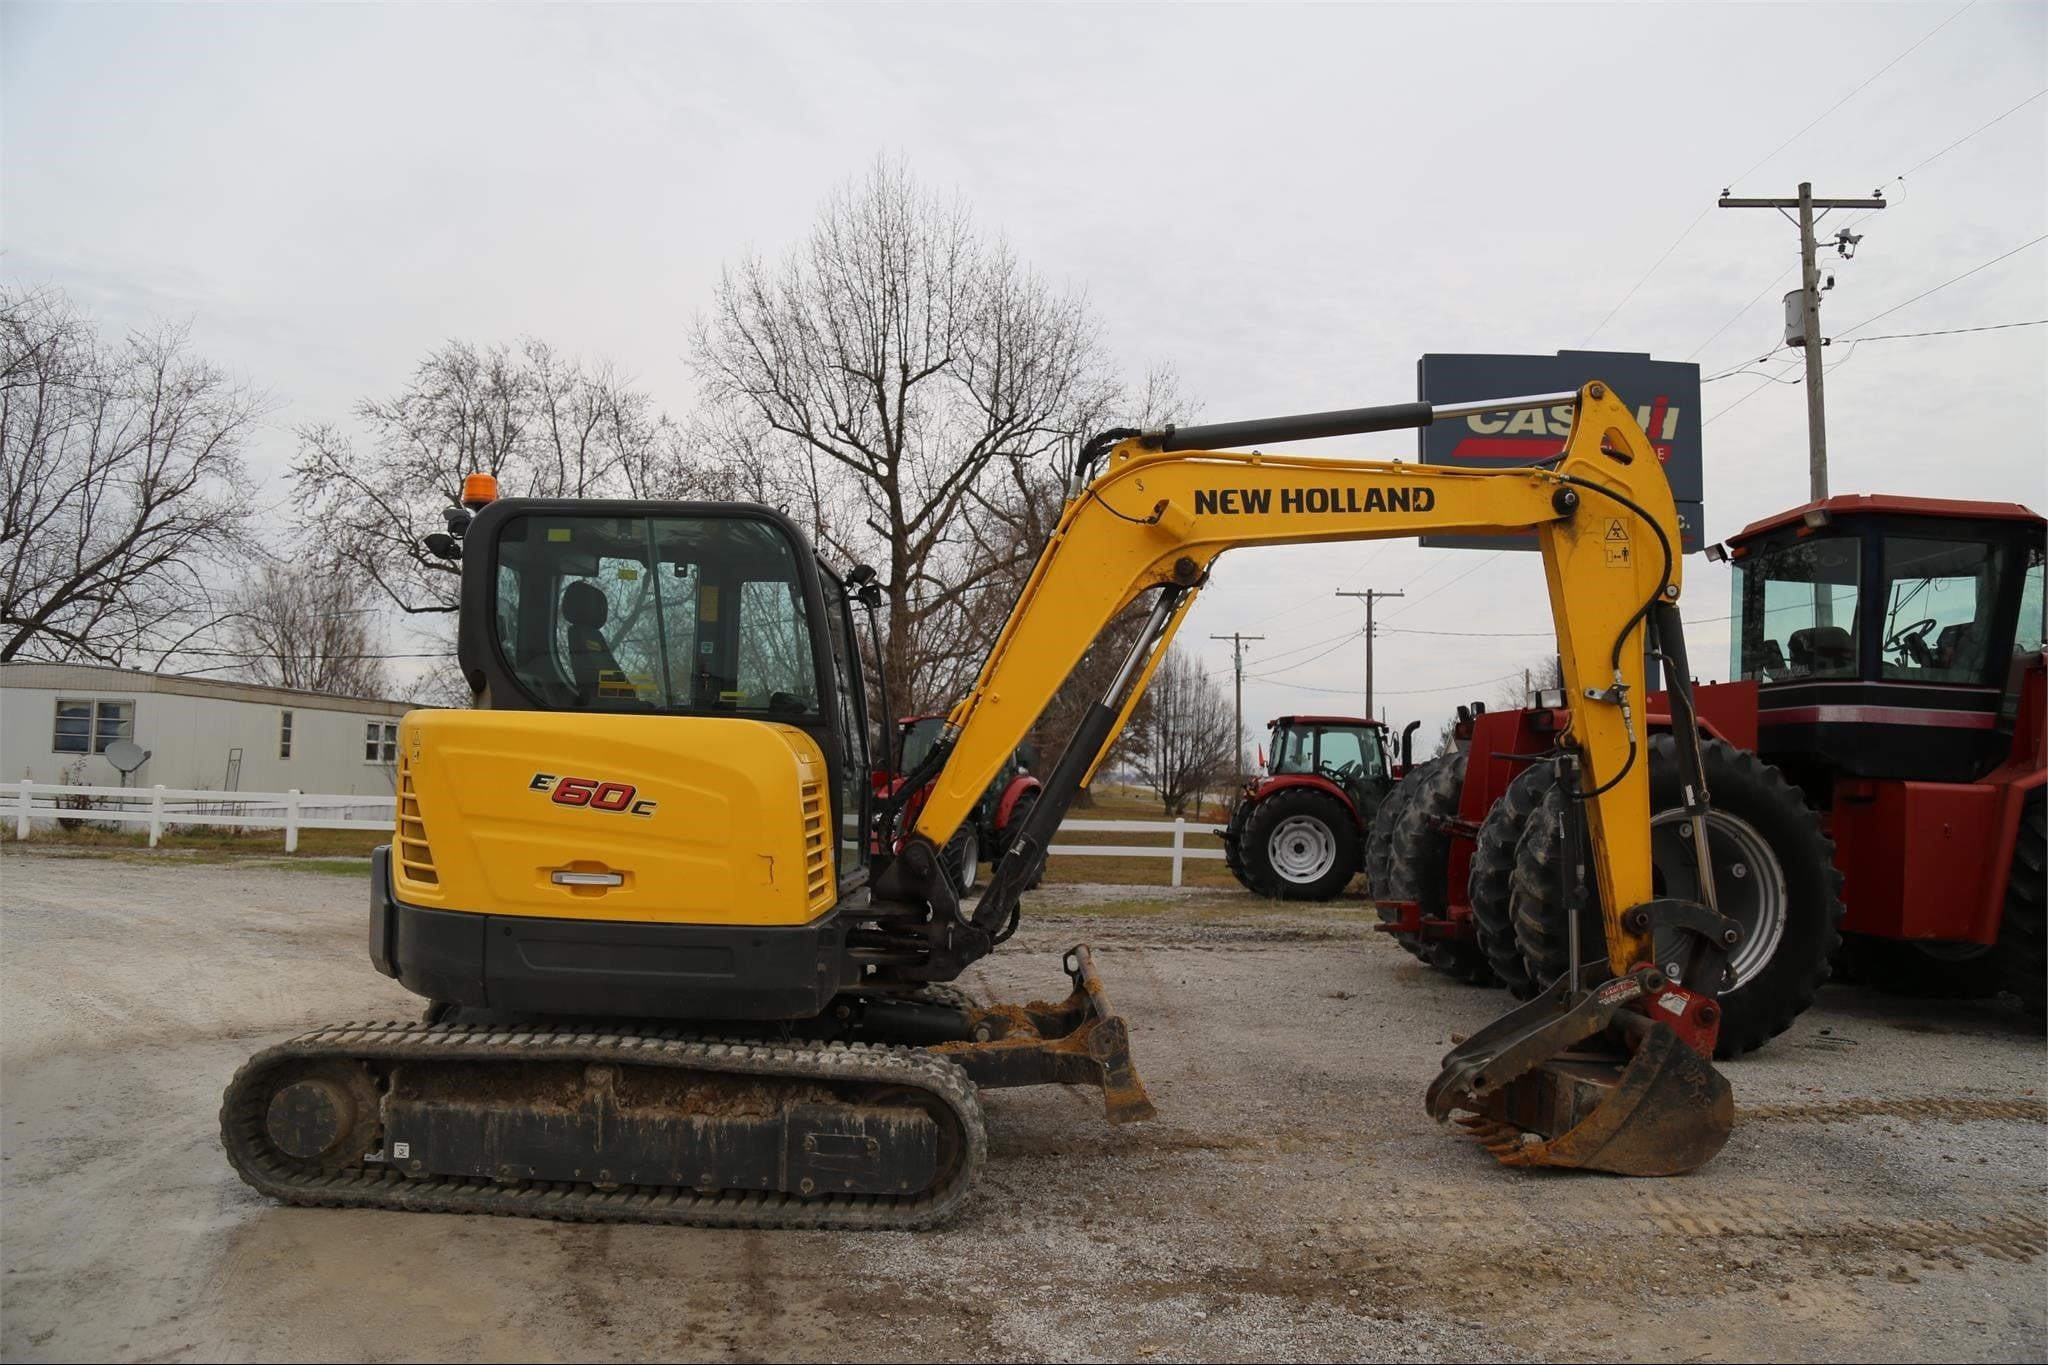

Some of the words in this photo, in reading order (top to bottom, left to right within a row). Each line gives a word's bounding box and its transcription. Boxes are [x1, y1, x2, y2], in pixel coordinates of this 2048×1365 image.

[1466, 404, 1575, 435] CAS
[1195, 489, 1272, 515] NEW
[1281, 487, 1436, 513] HOLLAND
